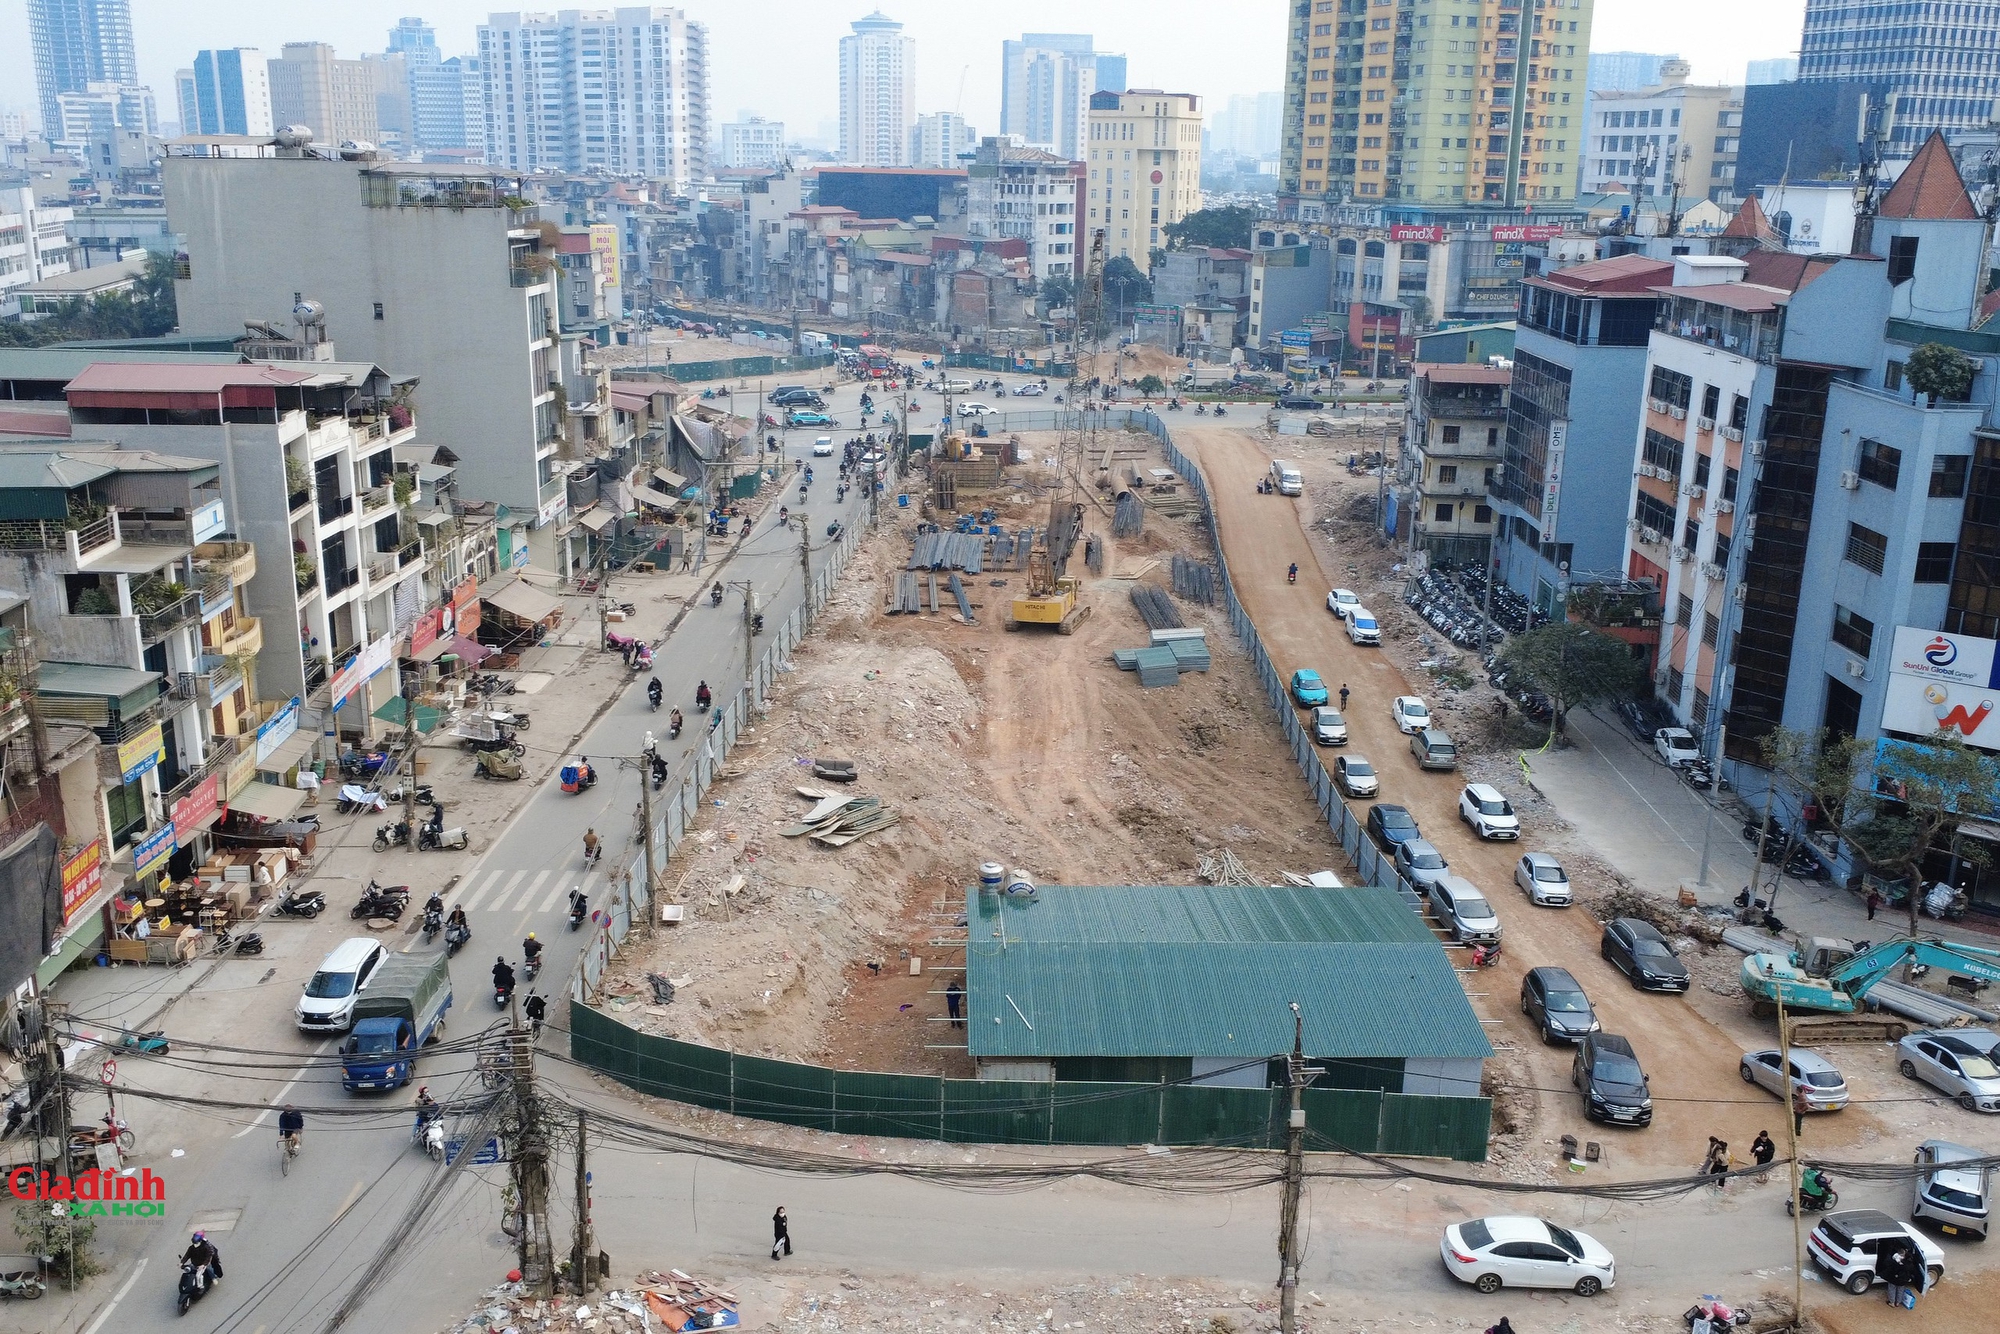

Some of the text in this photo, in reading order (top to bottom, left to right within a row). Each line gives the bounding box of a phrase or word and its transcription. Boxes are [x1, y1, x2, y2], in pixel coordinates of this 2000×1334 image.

[1397, 227, 1435, 240] mindX
[1494, 227, 1526, 240] mindX
[1902, 661, 1930, 672] SunUni
[1930, 666, 1955, 676] Global
[1866, 959, 1878, 968] 63
